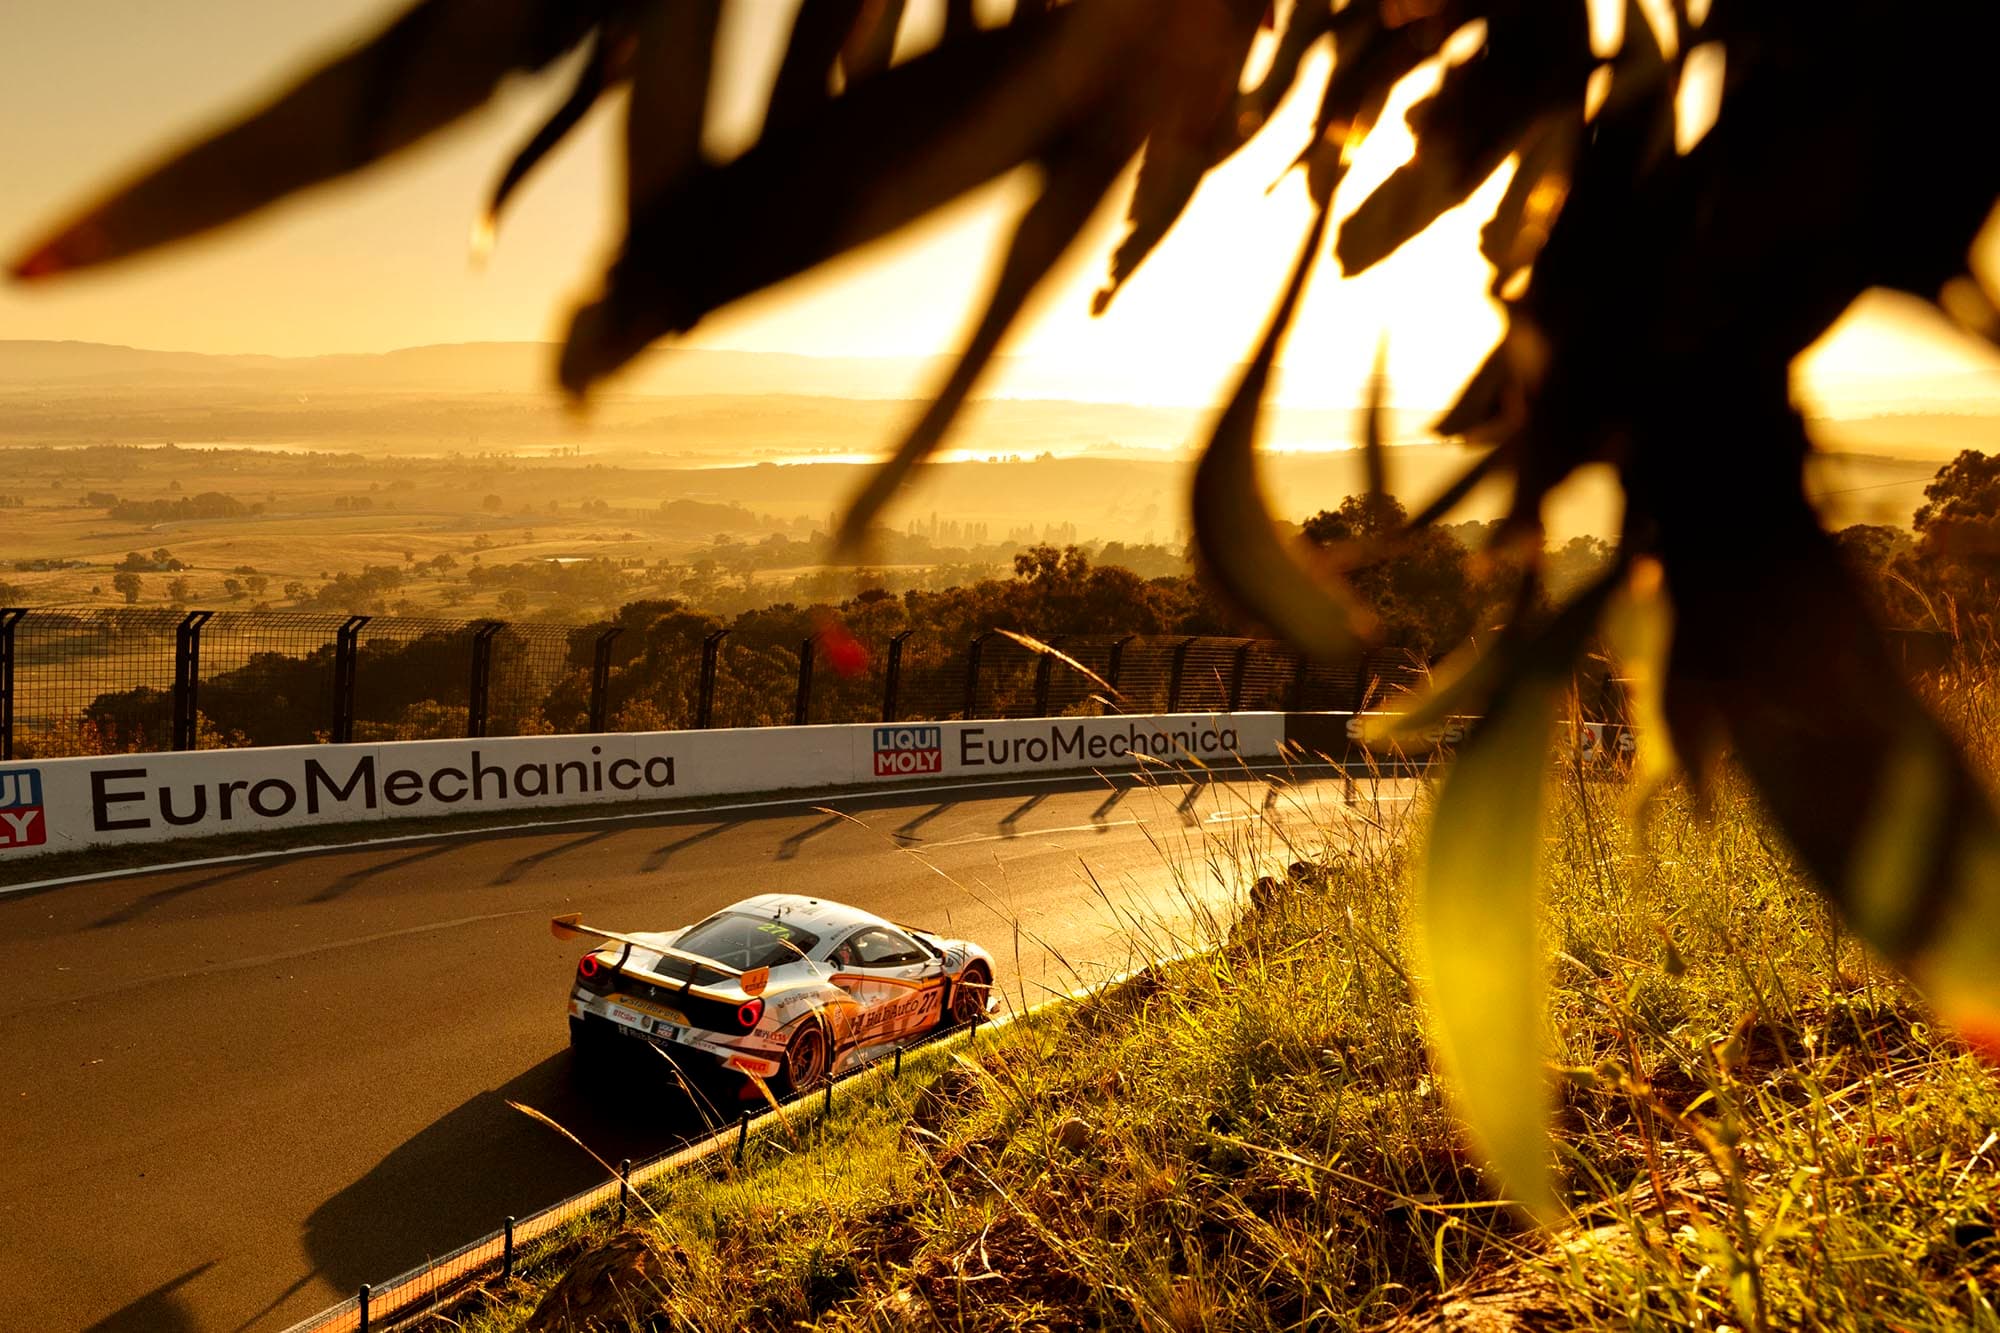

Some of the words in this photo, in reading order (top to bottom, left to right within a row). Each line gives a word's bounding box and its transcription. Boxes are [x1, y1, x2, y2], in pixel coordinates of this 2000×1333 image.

[877, 729, 937, 751] LIQUI
[960, 721, 1238, 766] EuroMechanica
[878, 751, 939, 773] MOLY
[90, 746, 676, 832] EuroMechanica
